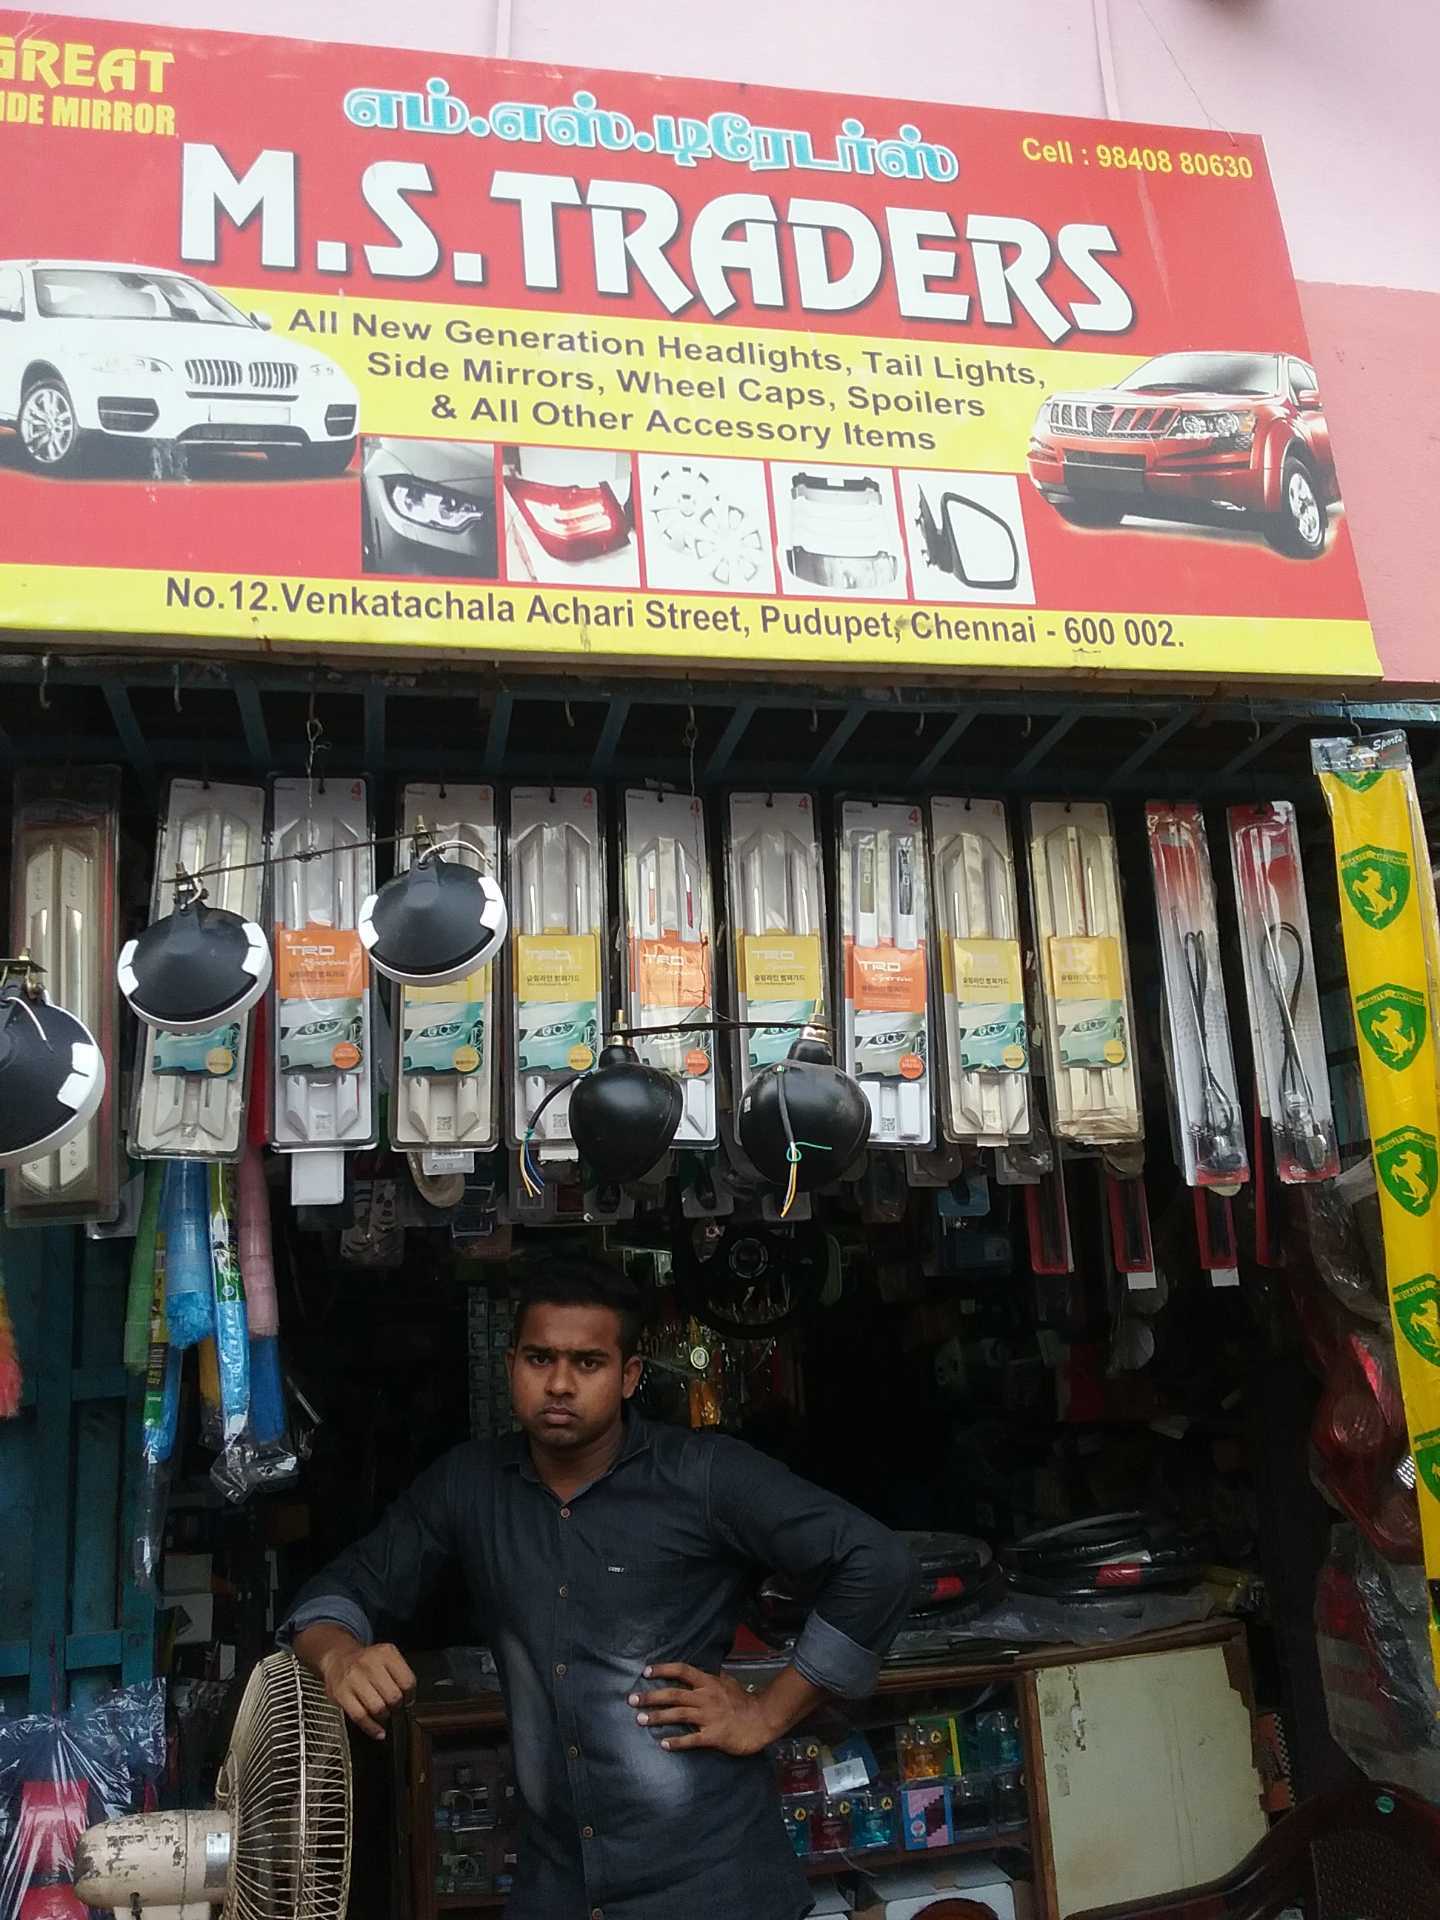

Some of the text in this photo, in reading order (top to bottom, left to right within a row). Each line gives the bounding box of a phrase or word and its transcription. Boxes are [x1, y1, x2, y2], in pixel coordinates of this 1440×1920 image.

[0, 90, 176, 136] IDE MIRROR
[1022, 138, 1253, 178] Cell : 98408 80630
[288, 308, 1047, 389] All New Generation Headlights, Tail Lights,
[367, 352, 986, 417] Side Mirrors, Wheel Caps, Spoilers
[431, 394, 936, 451] & All Other Accessory Items
[526, 593, 634, 628] Achari
[645, 600, 750, 638] Street,
[761, 605, 903, 645] Pudupet,
[910, 610, 1036, 643] Chennai
[1064, 616, 1115, 646] 600
[1125, 619, 1185, 648] 002.
[286, 945, 335, 956] TRD
[643, 954, 684, 966] TRD
[859, 960, 901, 972] TRD
